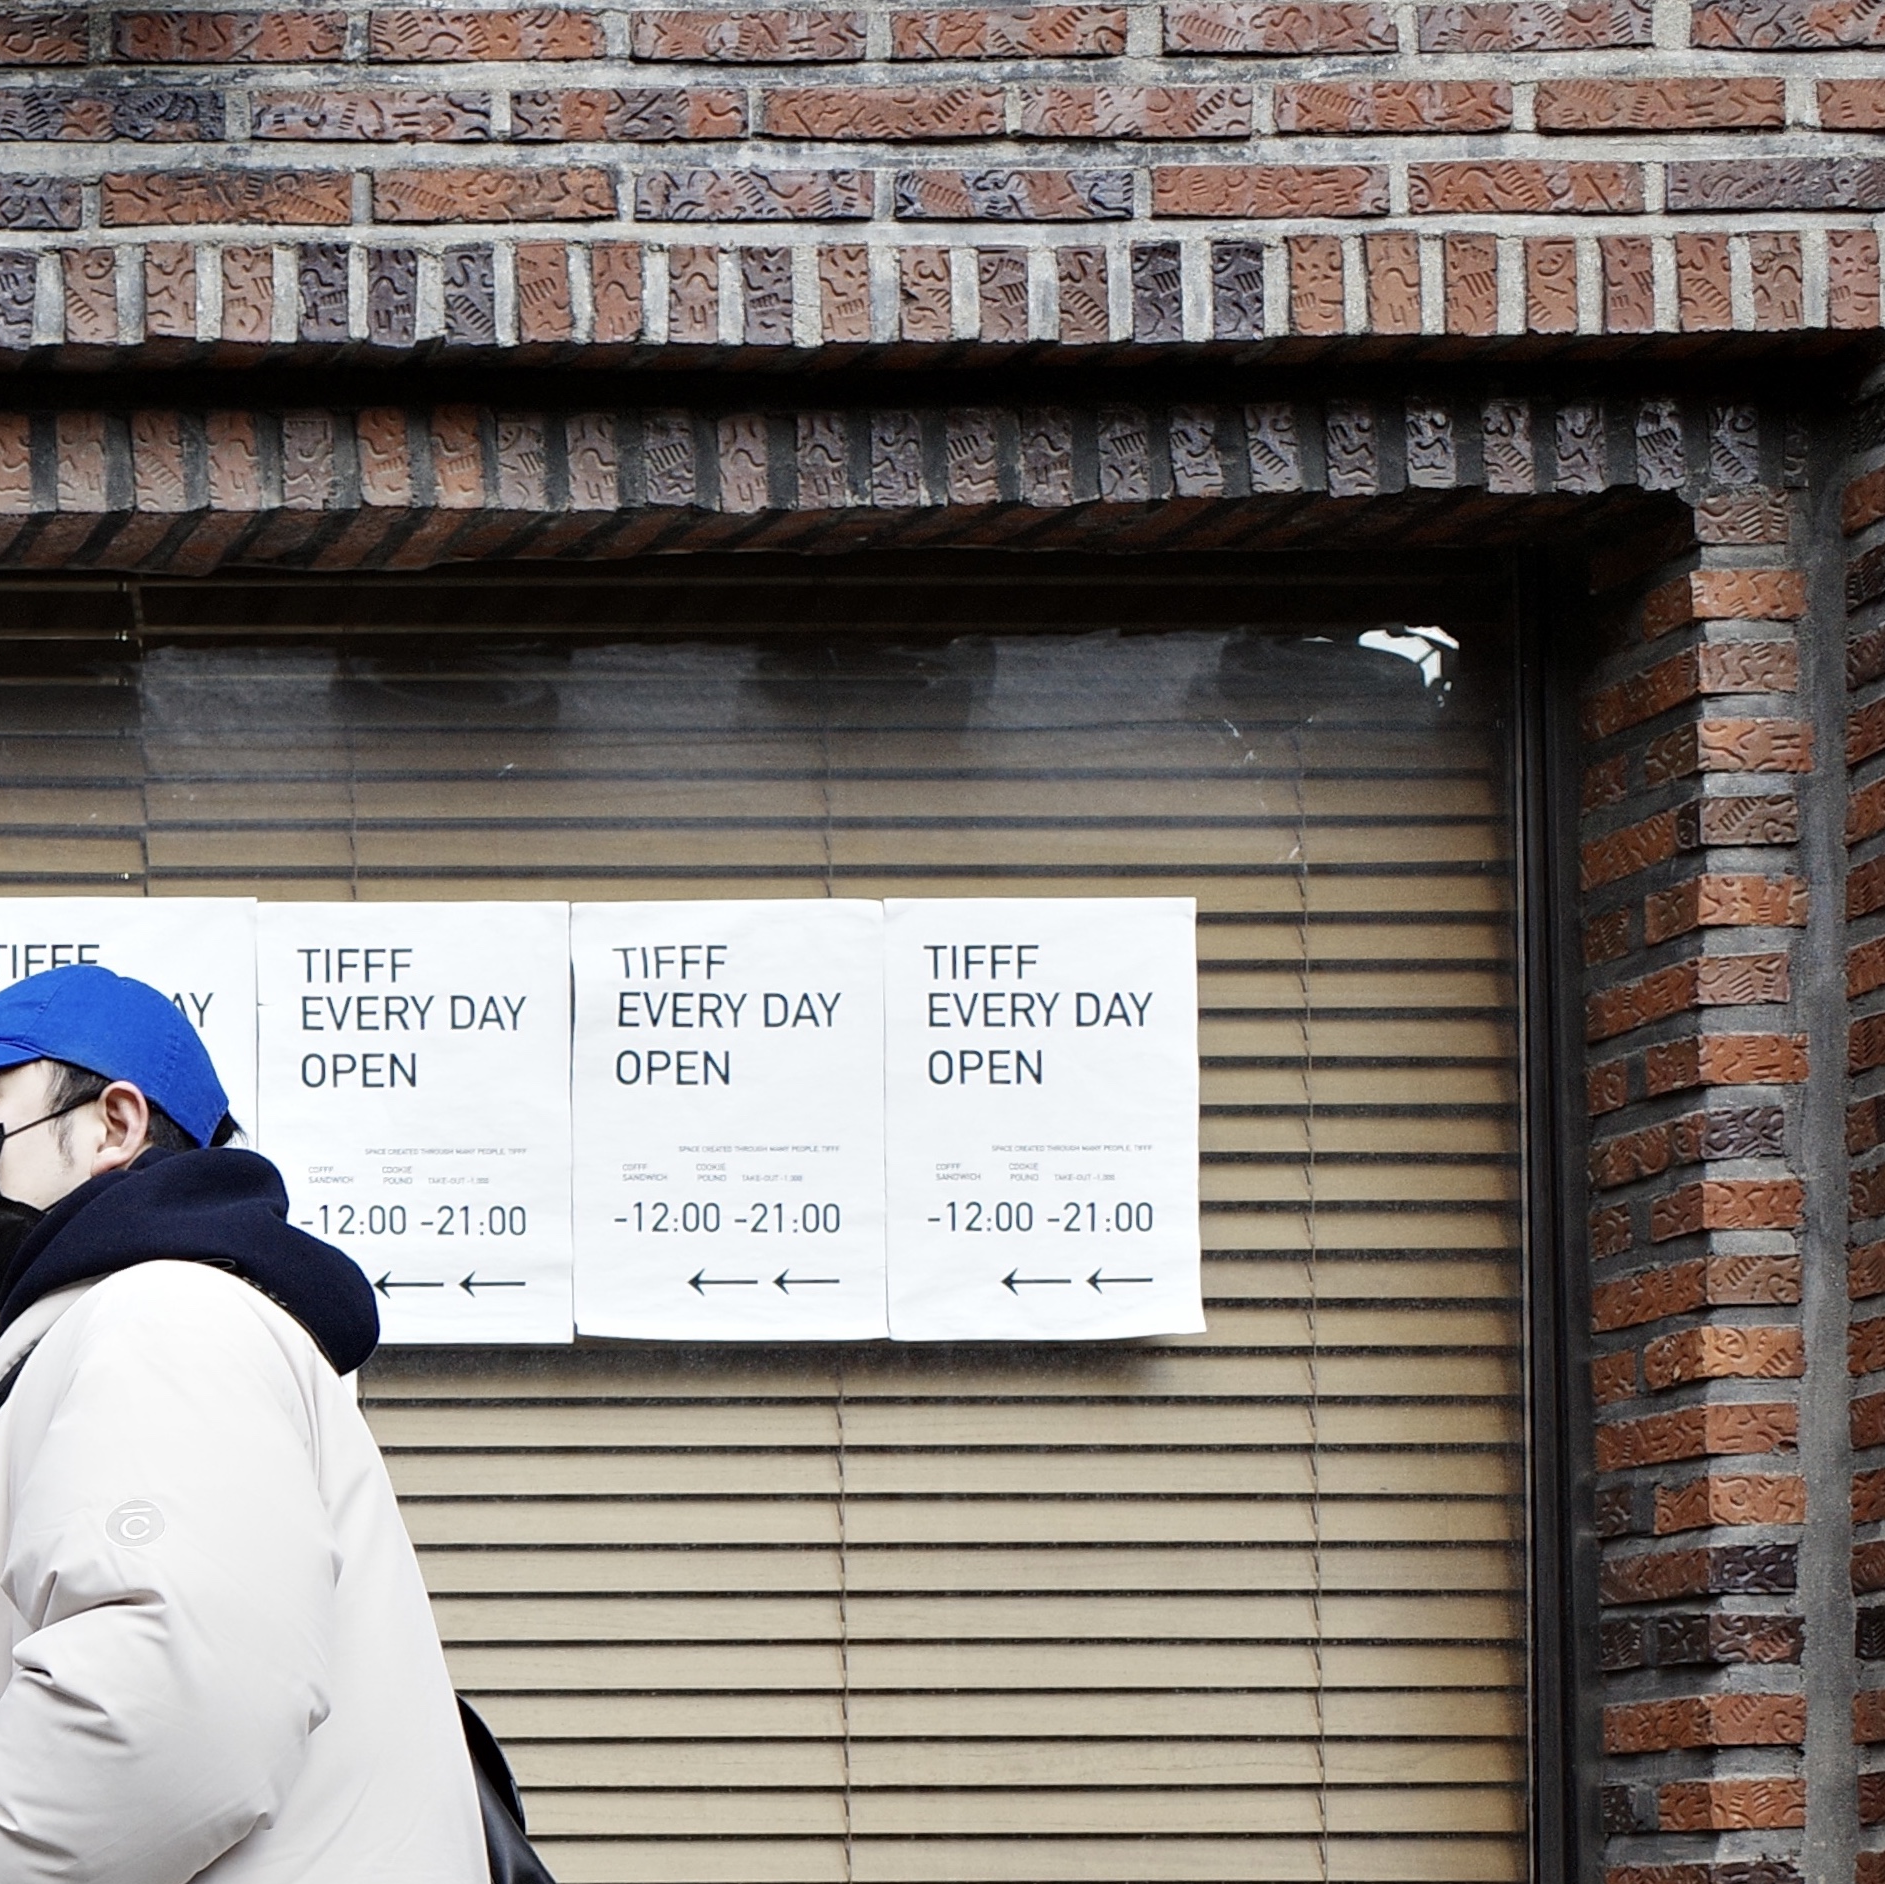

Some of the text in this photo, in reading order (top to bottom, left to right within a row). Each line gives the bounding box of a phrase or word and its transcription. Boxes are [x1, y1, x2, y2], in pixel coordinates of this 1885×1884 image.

[297, 949, 412, 983] TIFFF
[613, 945, 727, 979] TIFFF
[924, 945, 1039, 979] TIFFF
[302, 995, 526, 1031] EVERY DAY
[618, 992, 841, 1028] EVERY DAY
[928, 992, 1153, 1027] EVERY DAY
[302, 1053, 416, 1088] OPEN
[616, 1050, 729, 1085] OPEN
[929, 1050, 1042, 1084] OPEN
